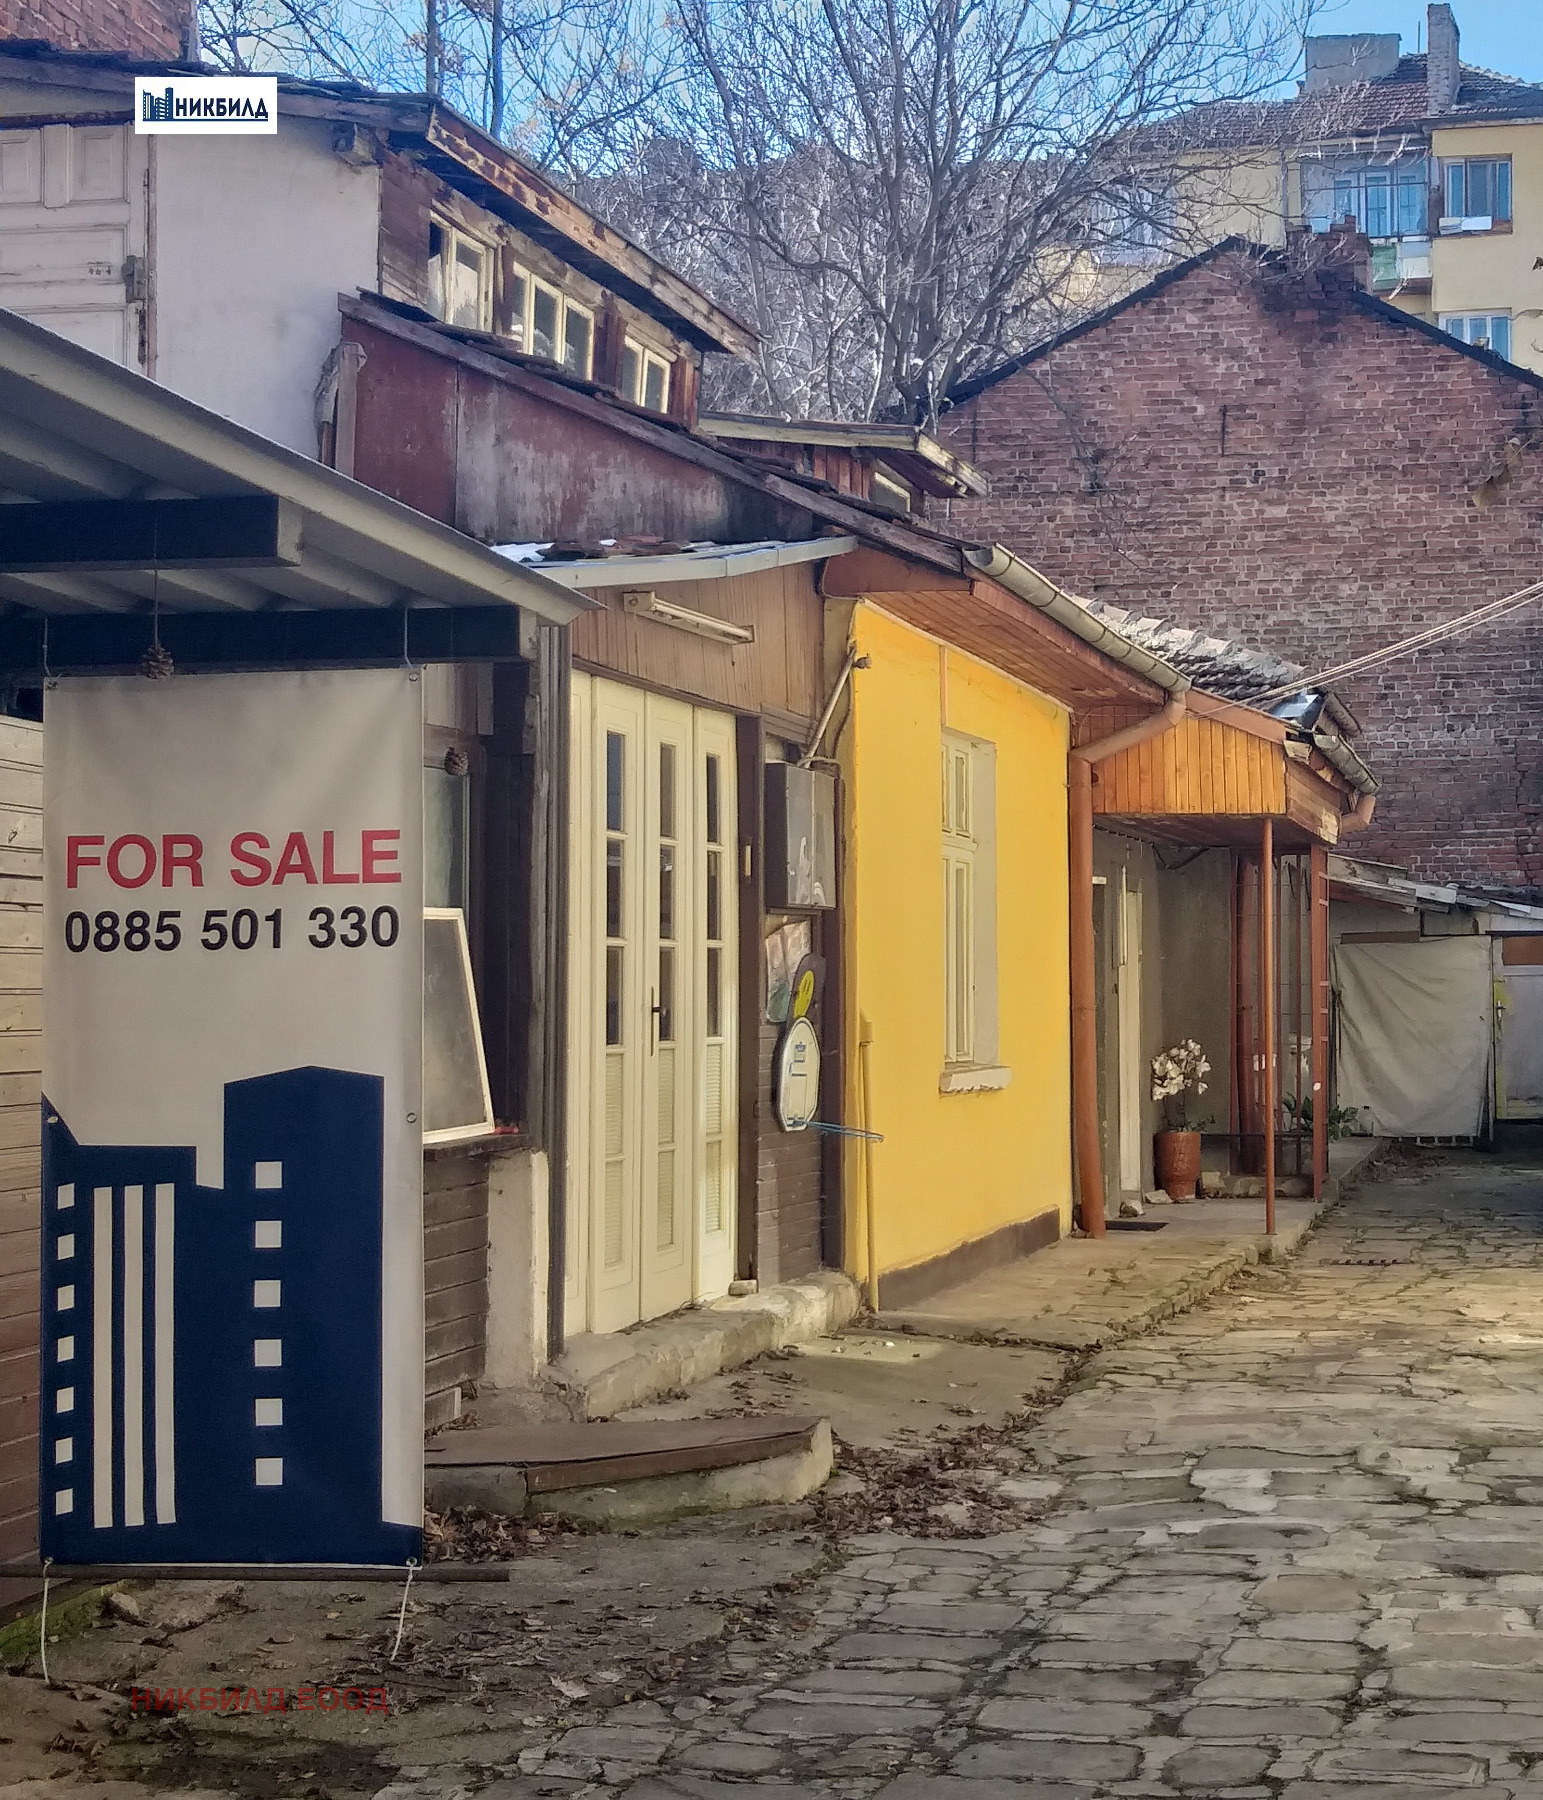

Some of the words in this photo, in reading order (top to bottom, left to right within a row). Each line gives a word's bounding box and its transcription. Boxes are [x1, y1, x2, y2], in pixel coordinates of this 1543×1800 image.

[66, 834, 205, 889] FOR
[229, 829, 402, 887] SALE
[65, 910, 182, 952] 0885
[200, 908, 282, 951] 501
[308, 905, 400, 949] 330
